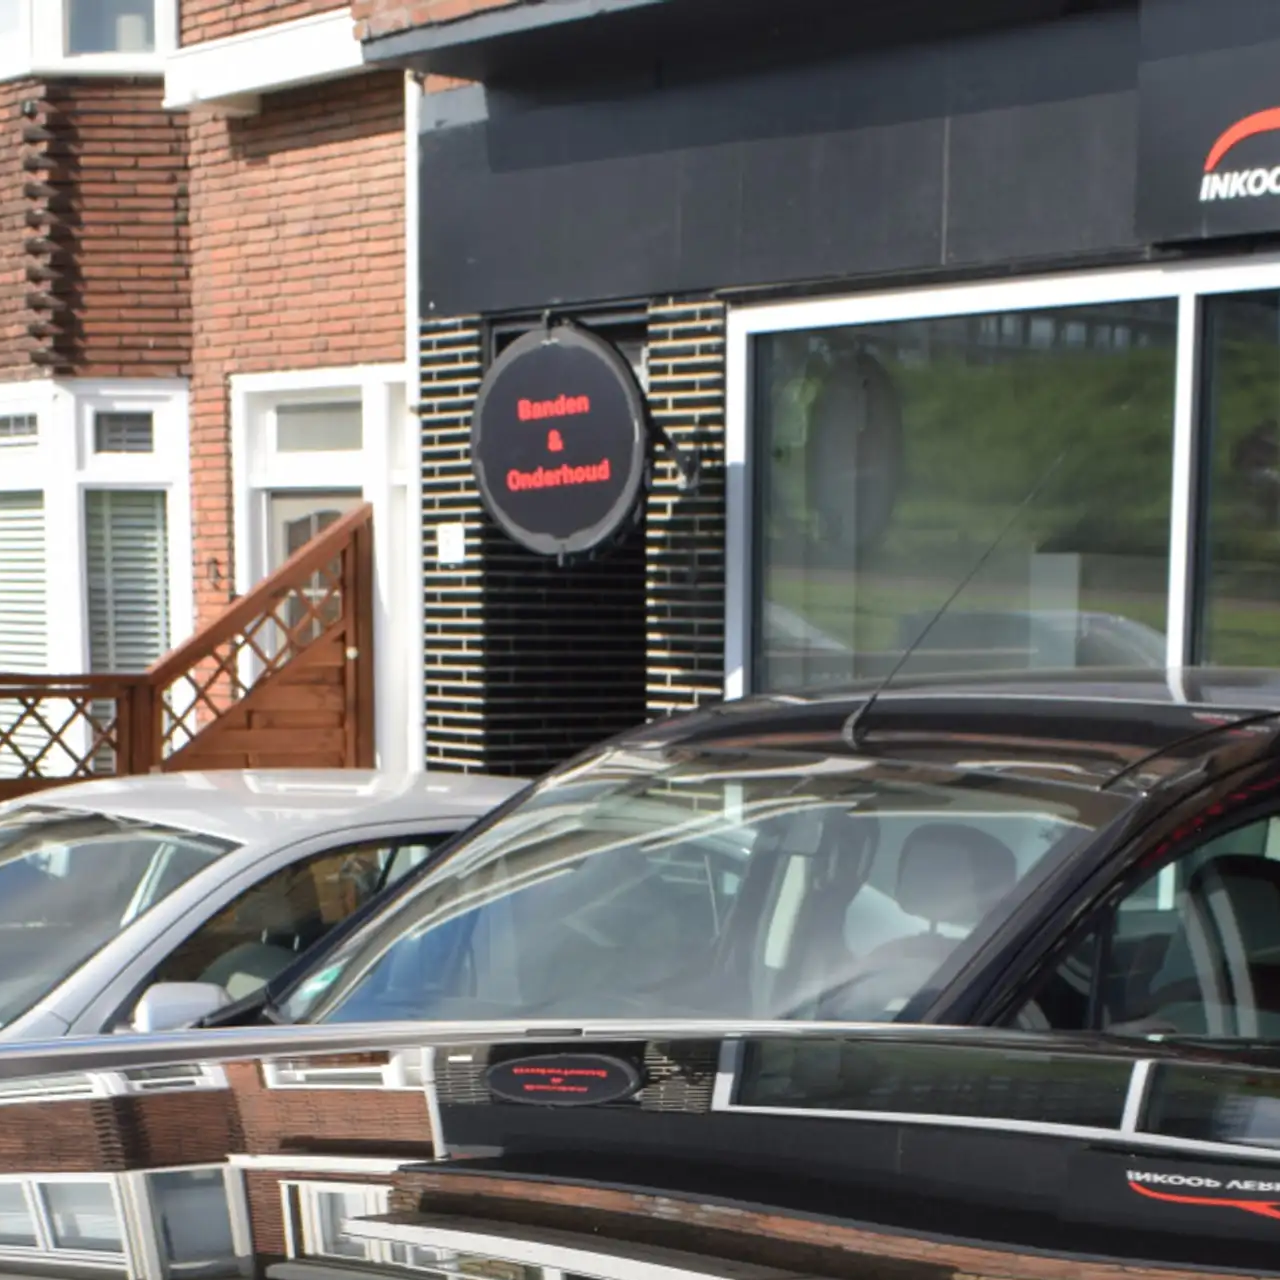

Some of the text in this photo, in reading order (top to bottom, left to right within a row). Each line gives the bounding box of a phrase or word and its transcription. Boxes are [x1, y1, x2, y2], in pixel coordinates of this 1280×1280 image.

[517, 394, 590, 421] Banden
[547, 428, 564, 452] &
[506, 458, 611, 492] Onderhoud
